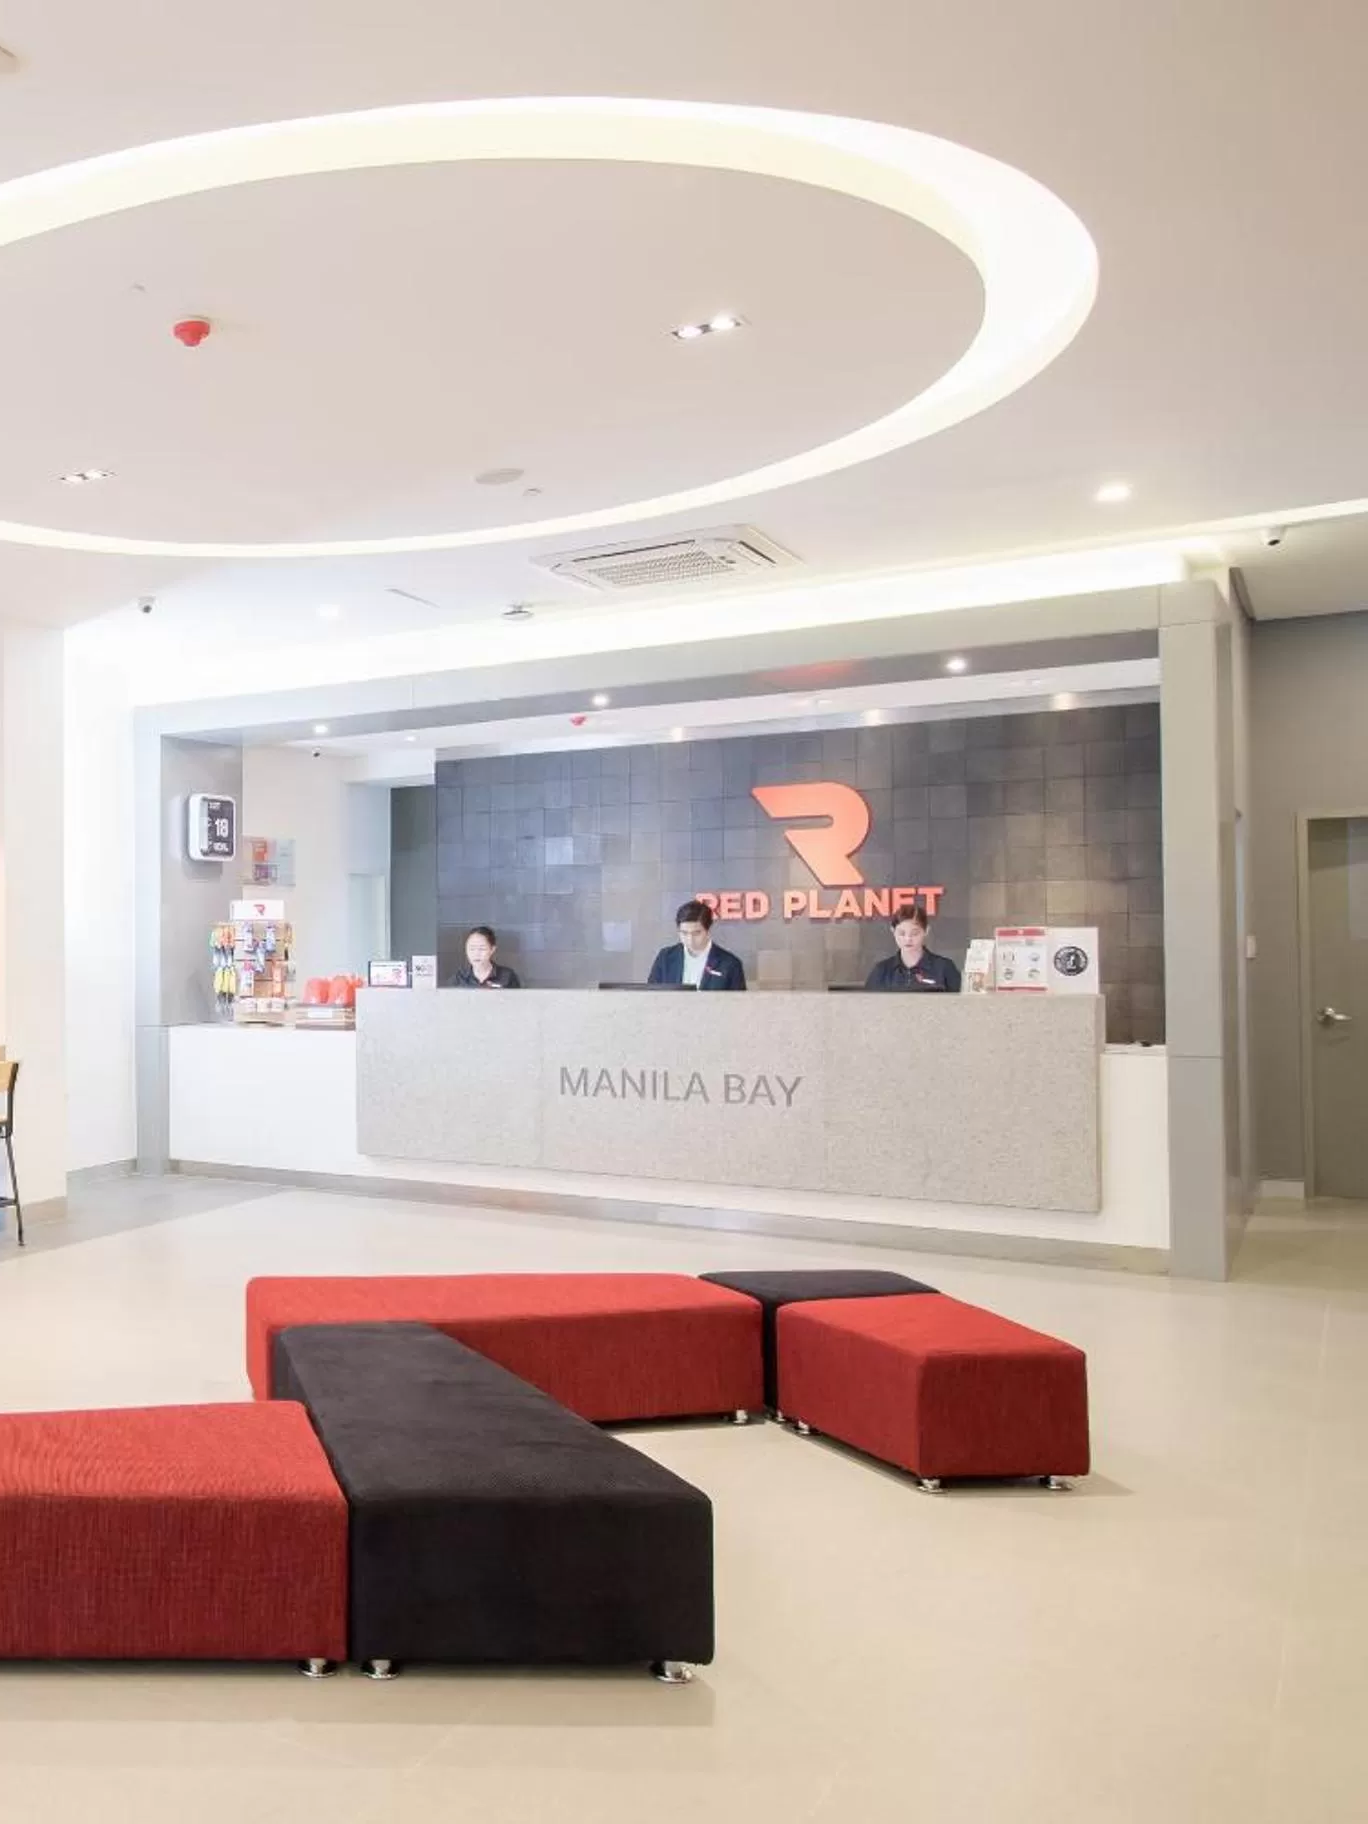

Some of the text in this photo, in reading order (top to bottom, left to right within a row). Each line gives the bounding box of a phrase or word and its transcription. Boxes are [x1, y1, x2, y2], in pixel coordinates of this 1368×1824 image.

[694, 886, 945, 921] RED PLANET
[559, 1066, 806, 1107] MANILA BAY
